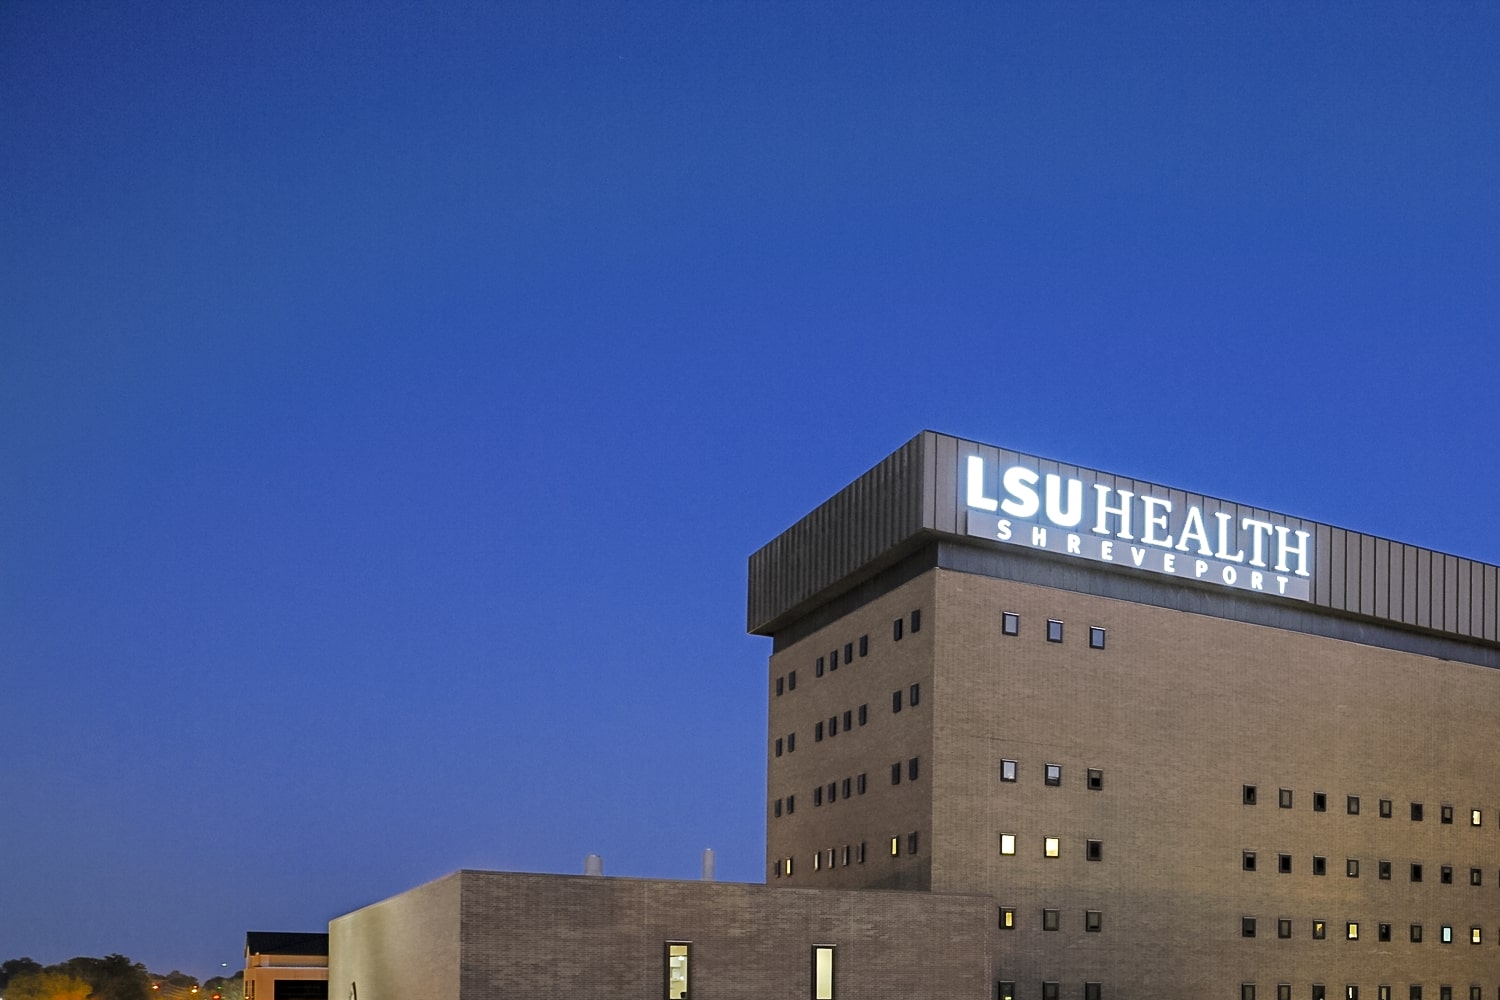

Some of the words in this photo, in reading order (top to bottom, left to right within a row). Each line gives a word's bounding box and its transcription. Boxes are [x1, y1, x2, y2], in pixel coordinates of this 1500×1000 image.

[966, 455, 1083, 527] LSU
[1091, 483, 1311, 577] HEALTH
[996, 519, 1290, 595] SHREVEPORT
